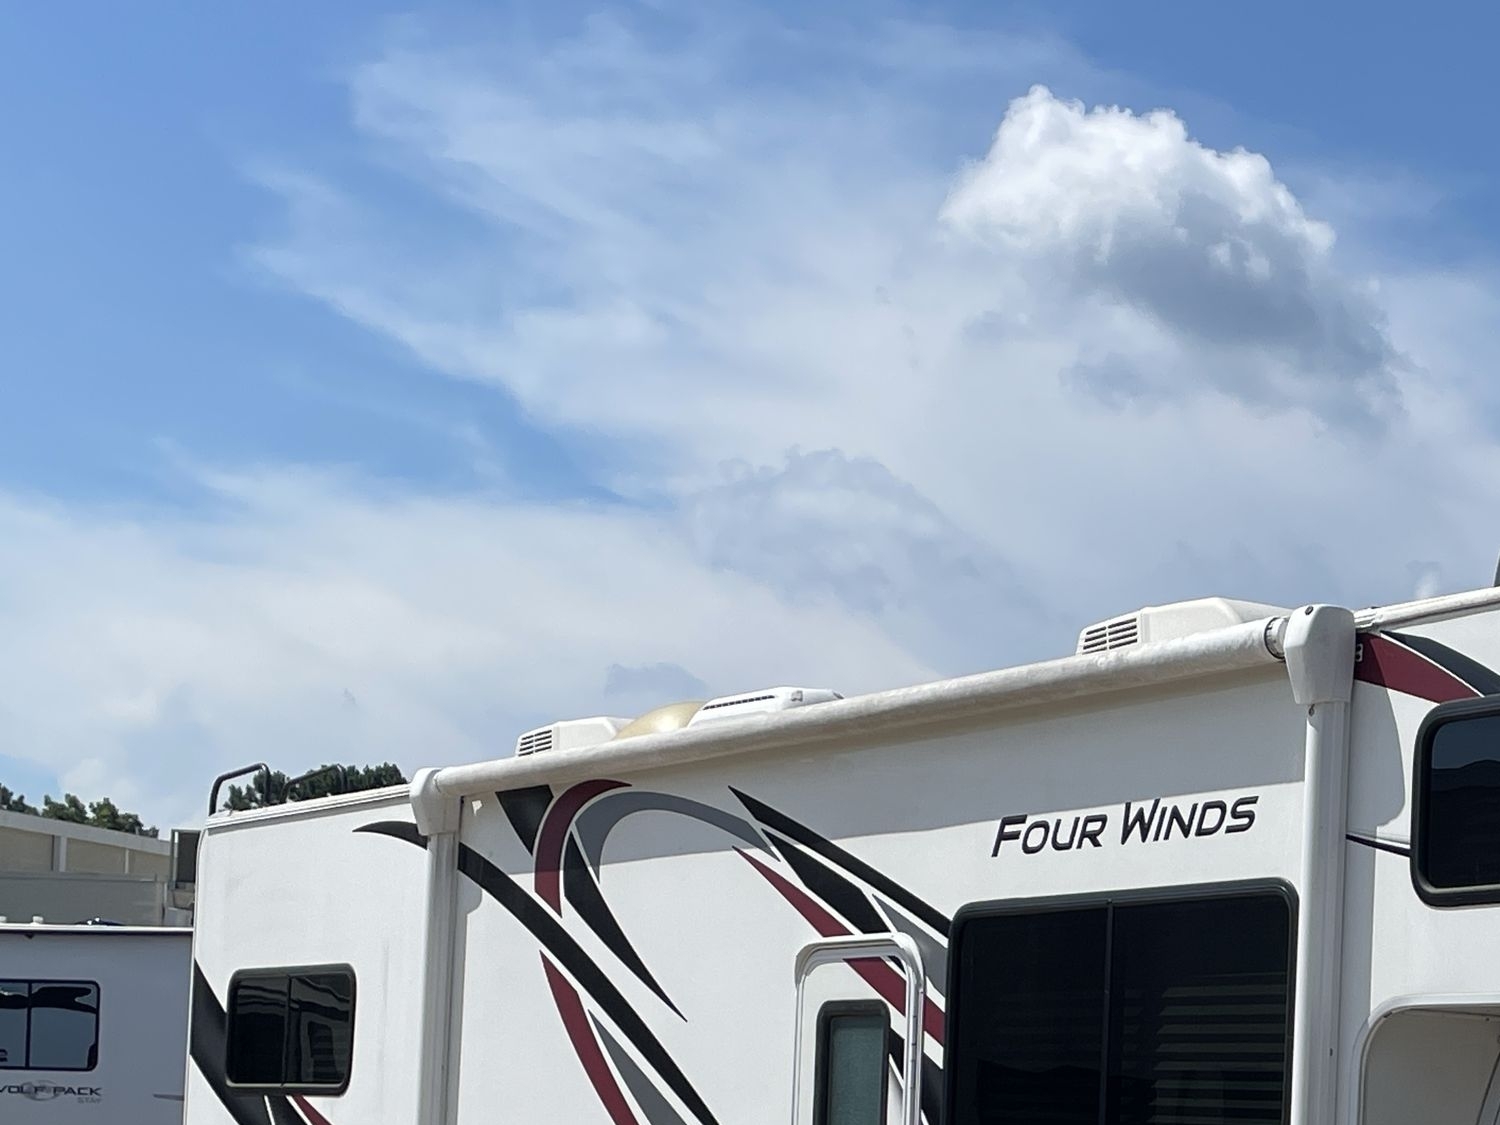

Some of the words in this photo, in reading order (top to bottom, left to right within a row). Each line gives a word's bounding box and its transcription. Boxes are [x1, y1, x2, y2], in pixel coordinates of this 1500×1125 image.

[991, 814, 1108, 858] FOUR
[1120, 796, 1260, 845] WINDS
[53, 1086, 103, 1097] PACK
